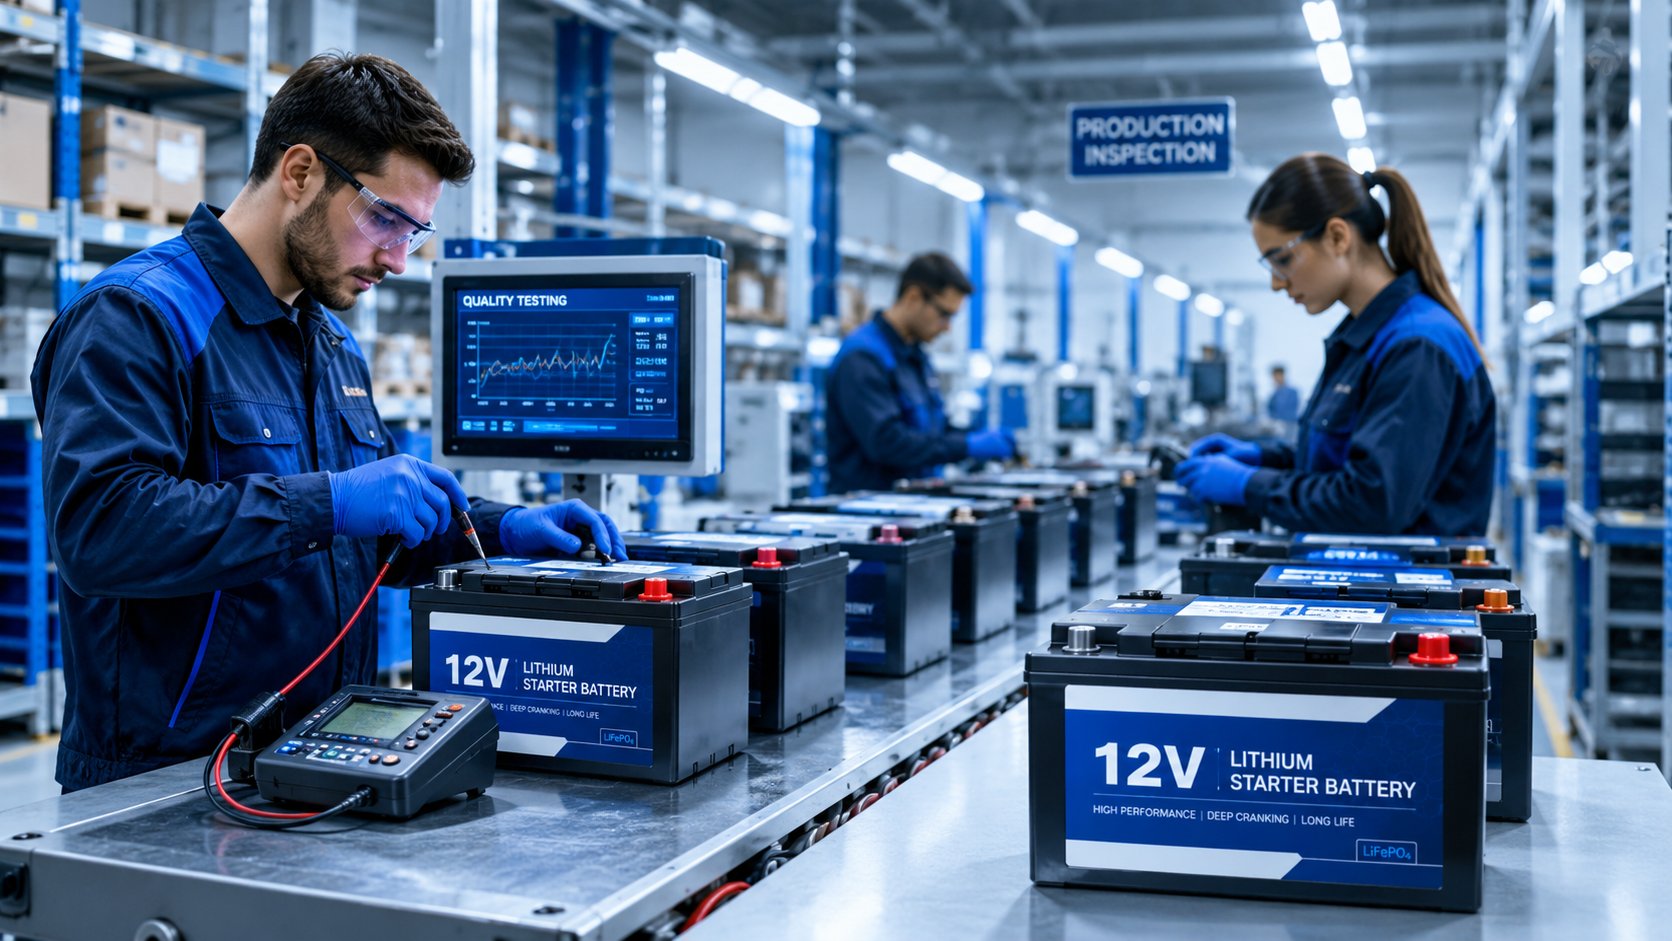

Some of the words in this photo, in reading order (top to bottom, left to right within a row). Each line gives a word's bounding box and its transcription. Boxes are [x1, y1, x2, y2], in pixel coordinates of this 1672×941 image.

[1076, 113, 1225, 140] PRODUCTION
[1084, 140, 1217, 167] INSPECTION
[463, 295, 514, 308] QUALITY
[517, 295, 567, 306] TESTING
[446, 654, 509, 688] 12V
[523, 661, 574, 677] LITHIUM
[523, 678, 577, 695] STARTER
[581, 682, 637, 699] BATTERY
[566, 709, 585, 718] LONG
[1095, 742, 1206, 789] 12V
[1231, 750, 1313, 770] LITHIUM
[1230, 773, 1319, 795] STARTER
[1326, 779, 1417, 799] BATTERY
[1093, 804, 1118, 815] HIGH
[1120, 806, 1196, 820] PERFORMANCE
[1207, 810, 1233, 821] DEEP
[1235, 812, 1289, 824] CRANKING
[1301, 815, 1331, 826] LONG
[1334, 817, 1355, 827] LIFE
